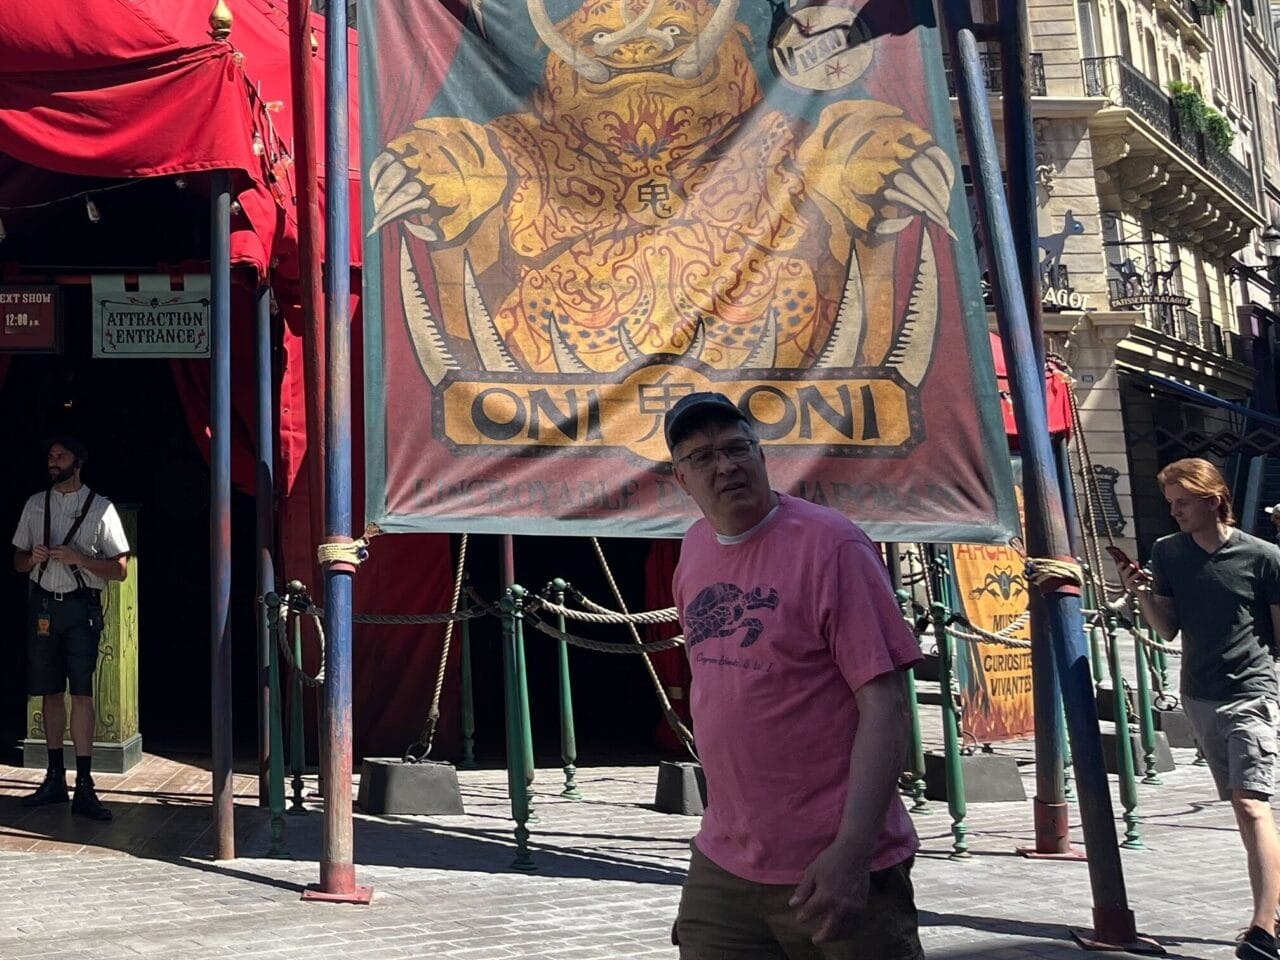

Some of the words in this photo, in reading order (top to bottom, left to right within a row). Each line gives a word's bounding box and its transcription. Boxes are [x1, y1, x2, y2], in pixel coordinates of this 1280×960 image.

[775, 27, 859, 77] VIVAN
[22, 293, 52, 304] SHOW
[1153, 295, 1190, 306] MATAGOT
[5, 313, 28, 327] 12:00
[106, 311, 203, 327] ATTRACTION
[116, 329, 196, 344] ENTRANCE
[471, 387, 603, 442] ONI
[738, 385, 880, 442] ONI
